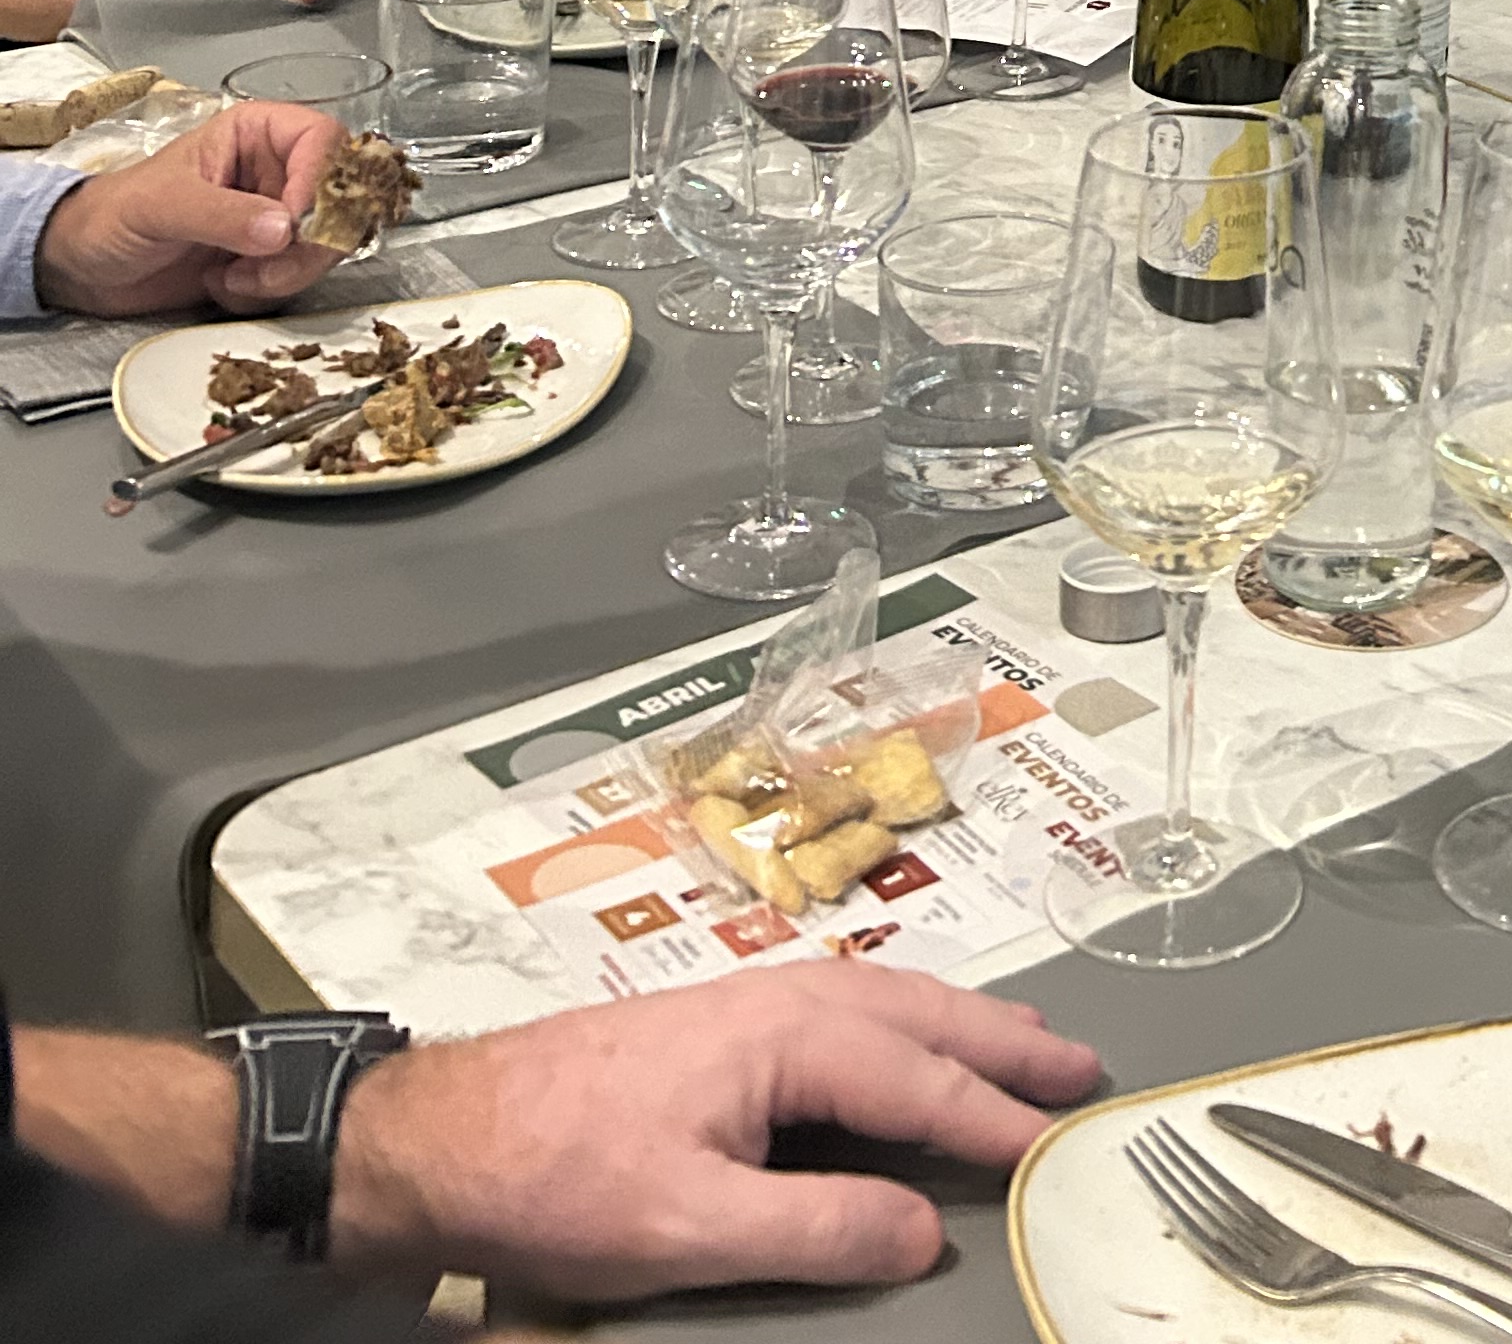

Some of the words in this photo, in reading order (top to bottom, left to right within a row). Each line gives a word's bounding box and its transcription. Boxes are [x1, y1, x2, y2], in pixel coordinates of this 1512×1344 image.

[956, 616, 1040, 670] CALENDARIO
[1037, 661, 1063, 683] DE
[616, 675, 726, 729] ABRIL
[998, 739, 1110, 823] EVENTOS
[1024, 731, 1102, 795] CALENDARIO
[1101, 789, 1130, 812] DE
